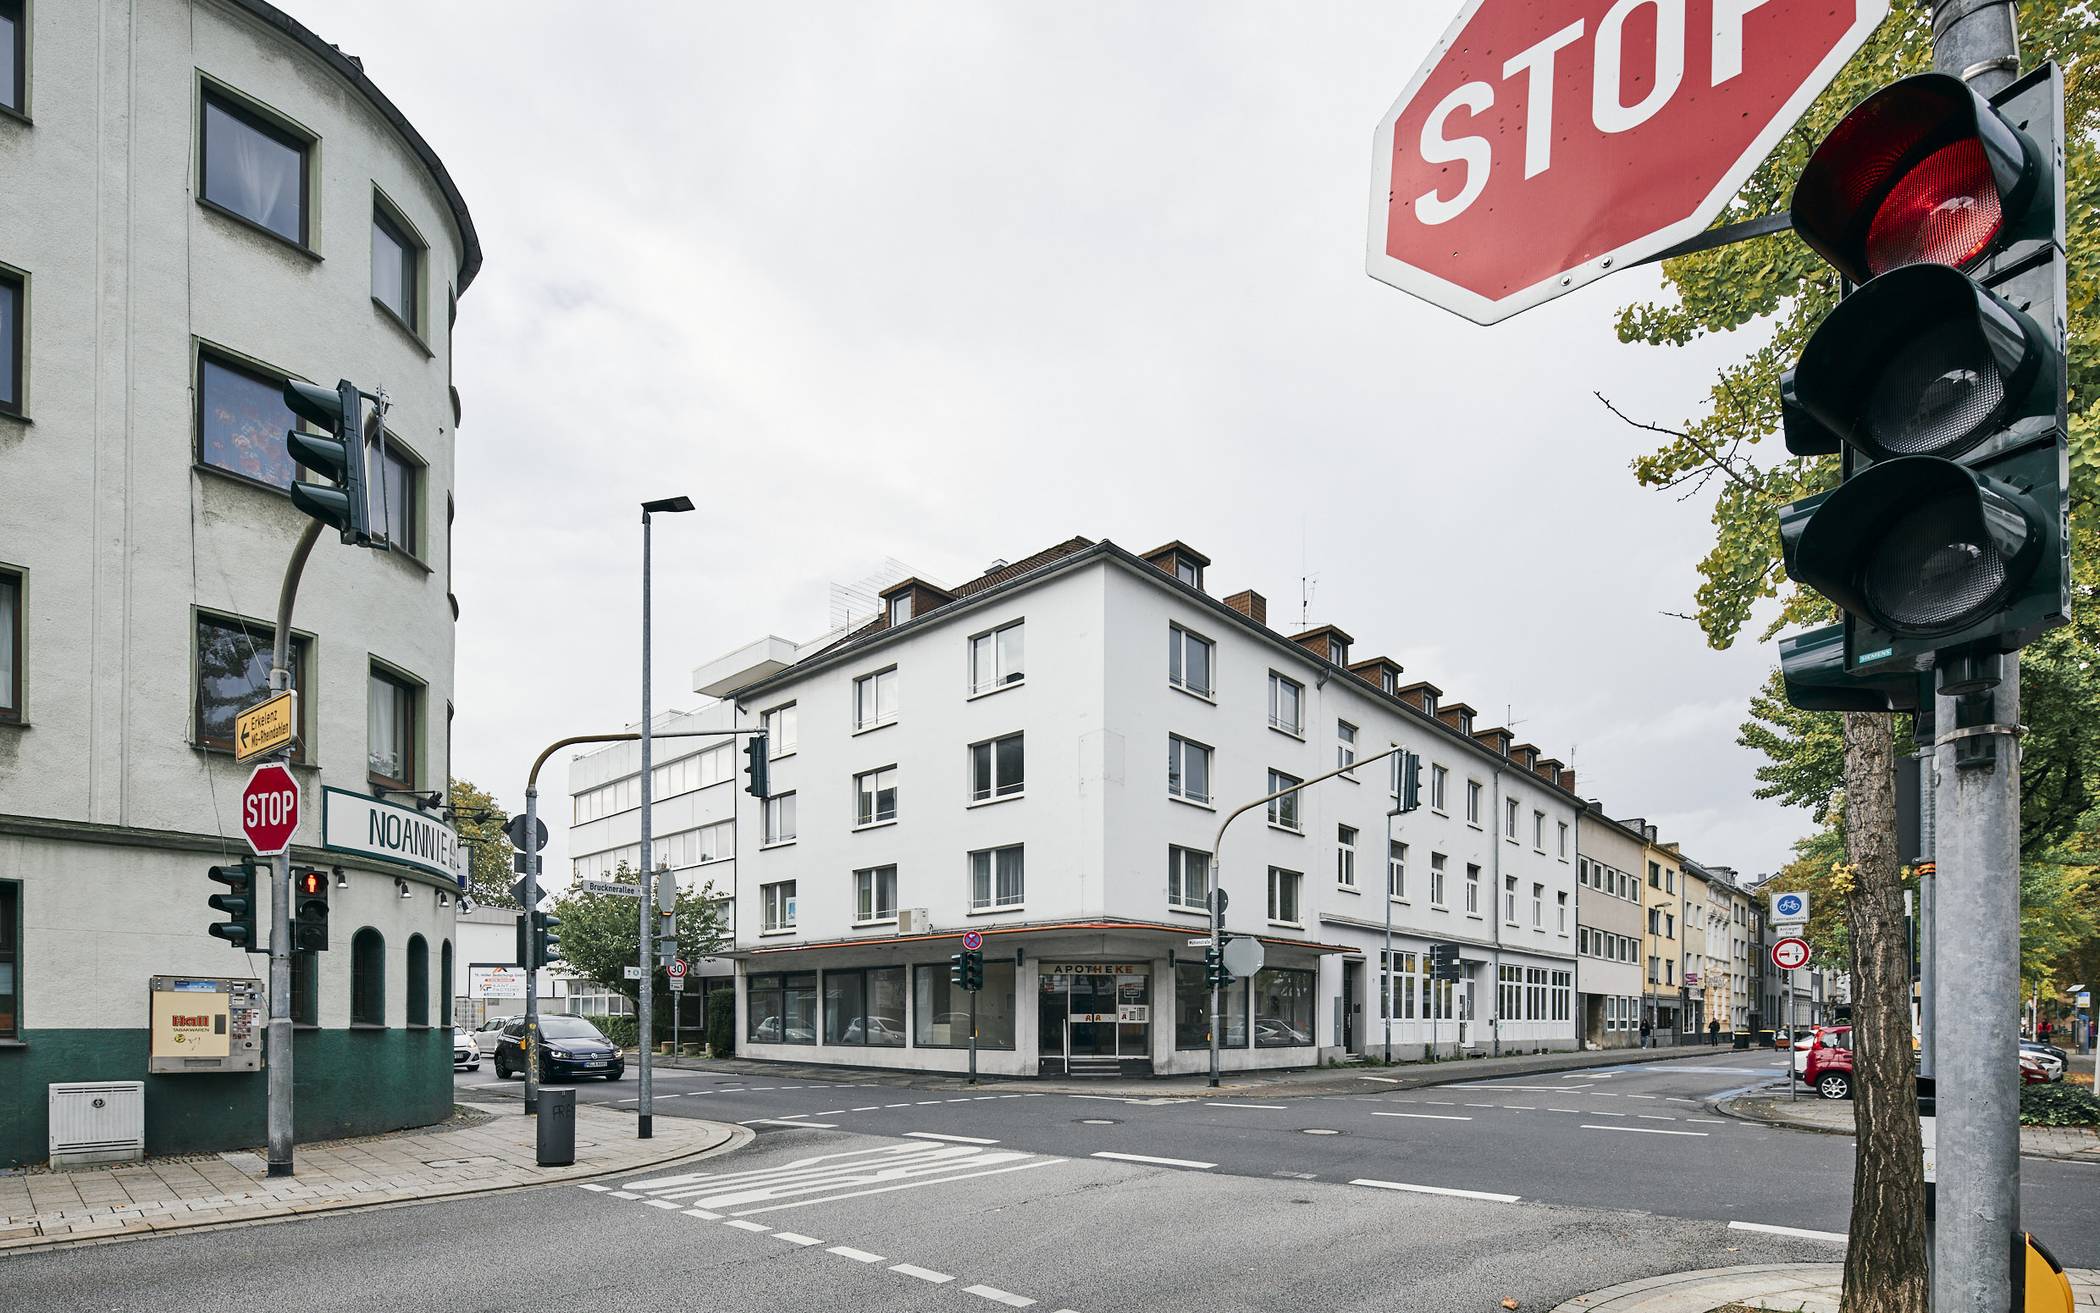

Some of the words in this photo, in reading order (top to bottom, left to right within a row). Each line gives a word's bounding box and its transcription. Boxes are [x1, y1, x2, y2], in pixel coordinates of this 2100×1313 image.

[251, 710, 278, 730] Erkelenz
[246, 790, 294, 828] STOP
[369, 808, 447, 865] NOANNIE
[589, 882, 635, 894] Brucknerallee
[671, 964, 683, 973] 30
[1054, 965, 1133, 974] APOTHEKE
[172, 1015, 209, 1026] Hall
